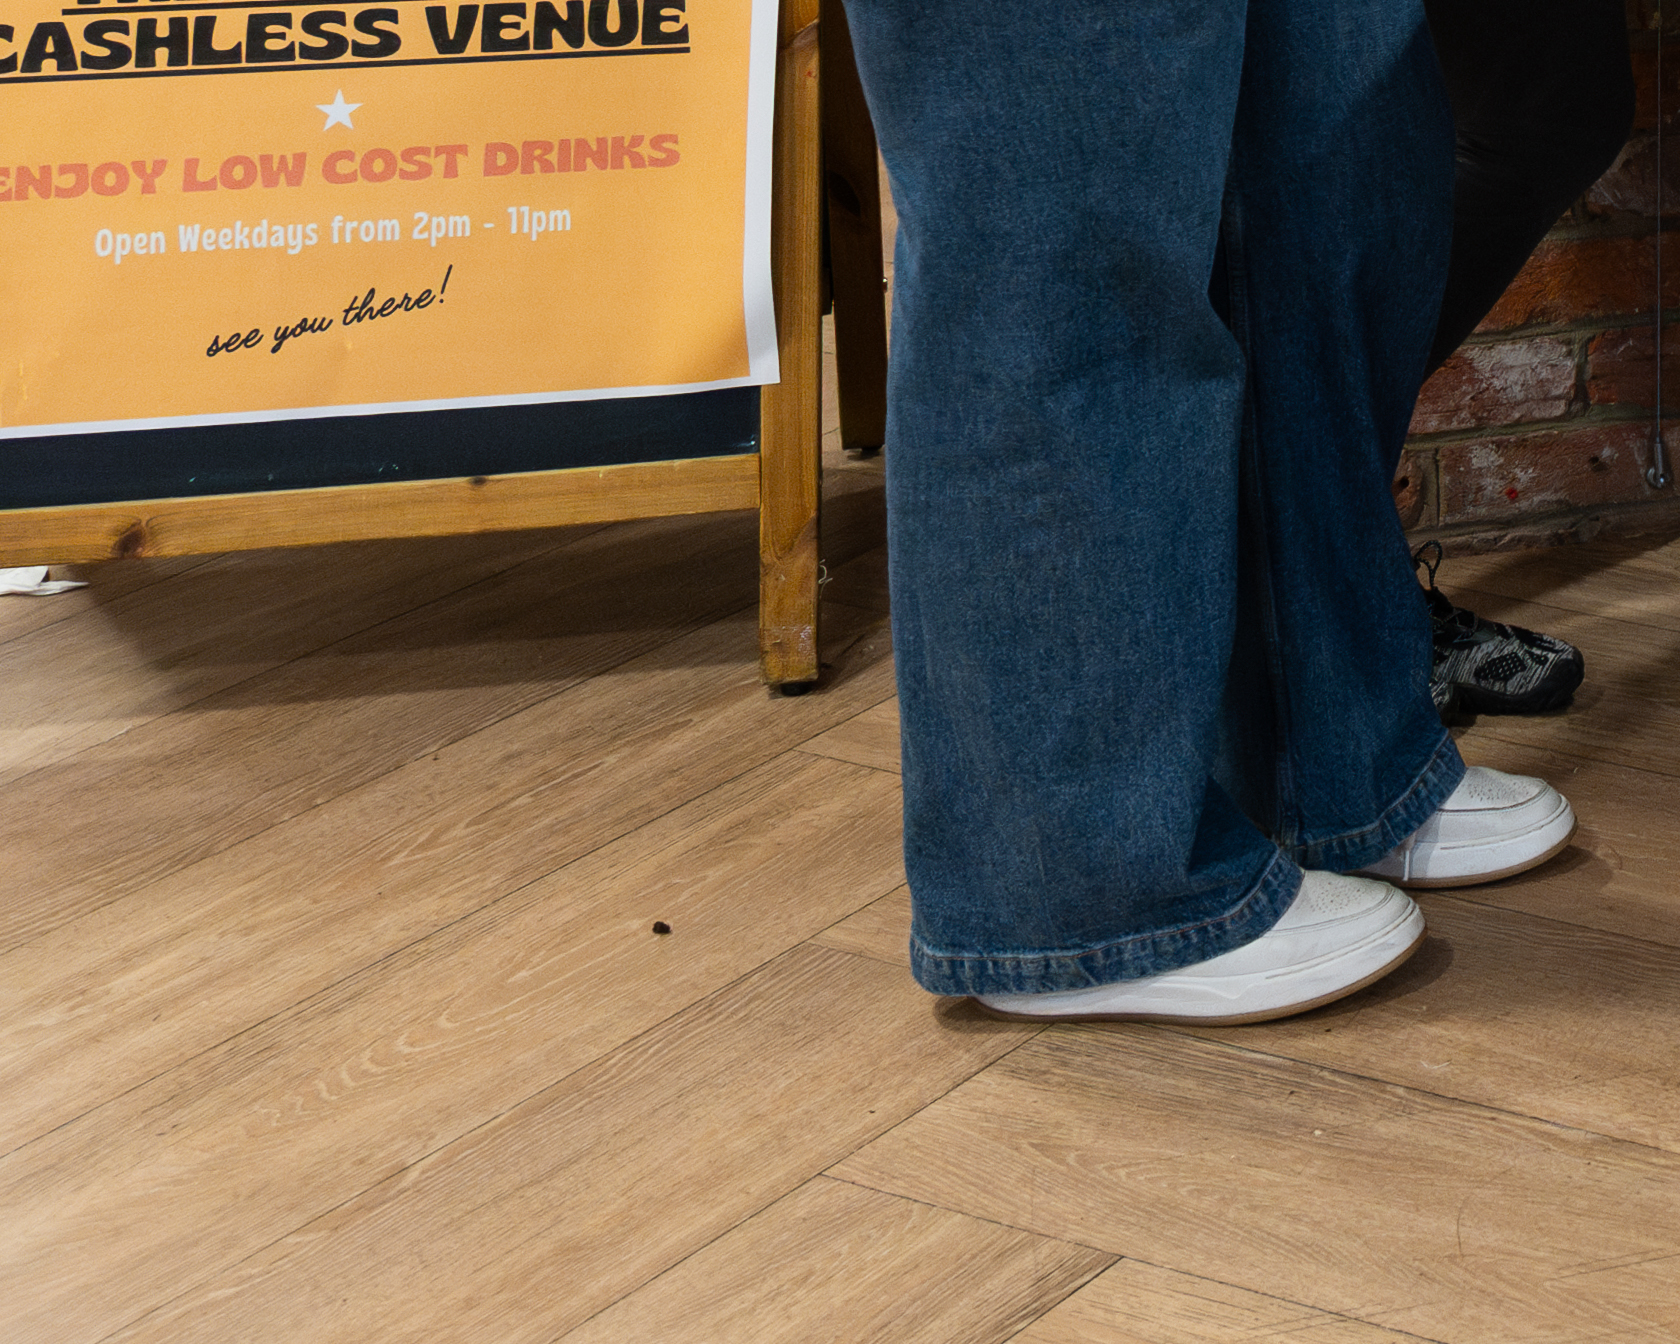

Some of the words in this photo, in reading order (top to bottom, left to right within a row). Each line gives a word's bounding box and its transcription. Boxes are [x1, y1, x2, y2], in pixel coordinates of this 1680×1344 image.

[182, 150, 308, 194] LOW
[321, 144, 469, 185] COST
[483, 133, 682, 177] DRINKS
[94, 227, 167, 265] Open
[178, 219, 320, 253] Weekdays
[330, 215, 402, 246] from
[411, 210, 472, 247] 2pm
[507, 205, 573, 238] 11pm
[206, 326, 264, 359] see
[271, 314, 334, 355] you
[342, 264, 454, 326] there!
